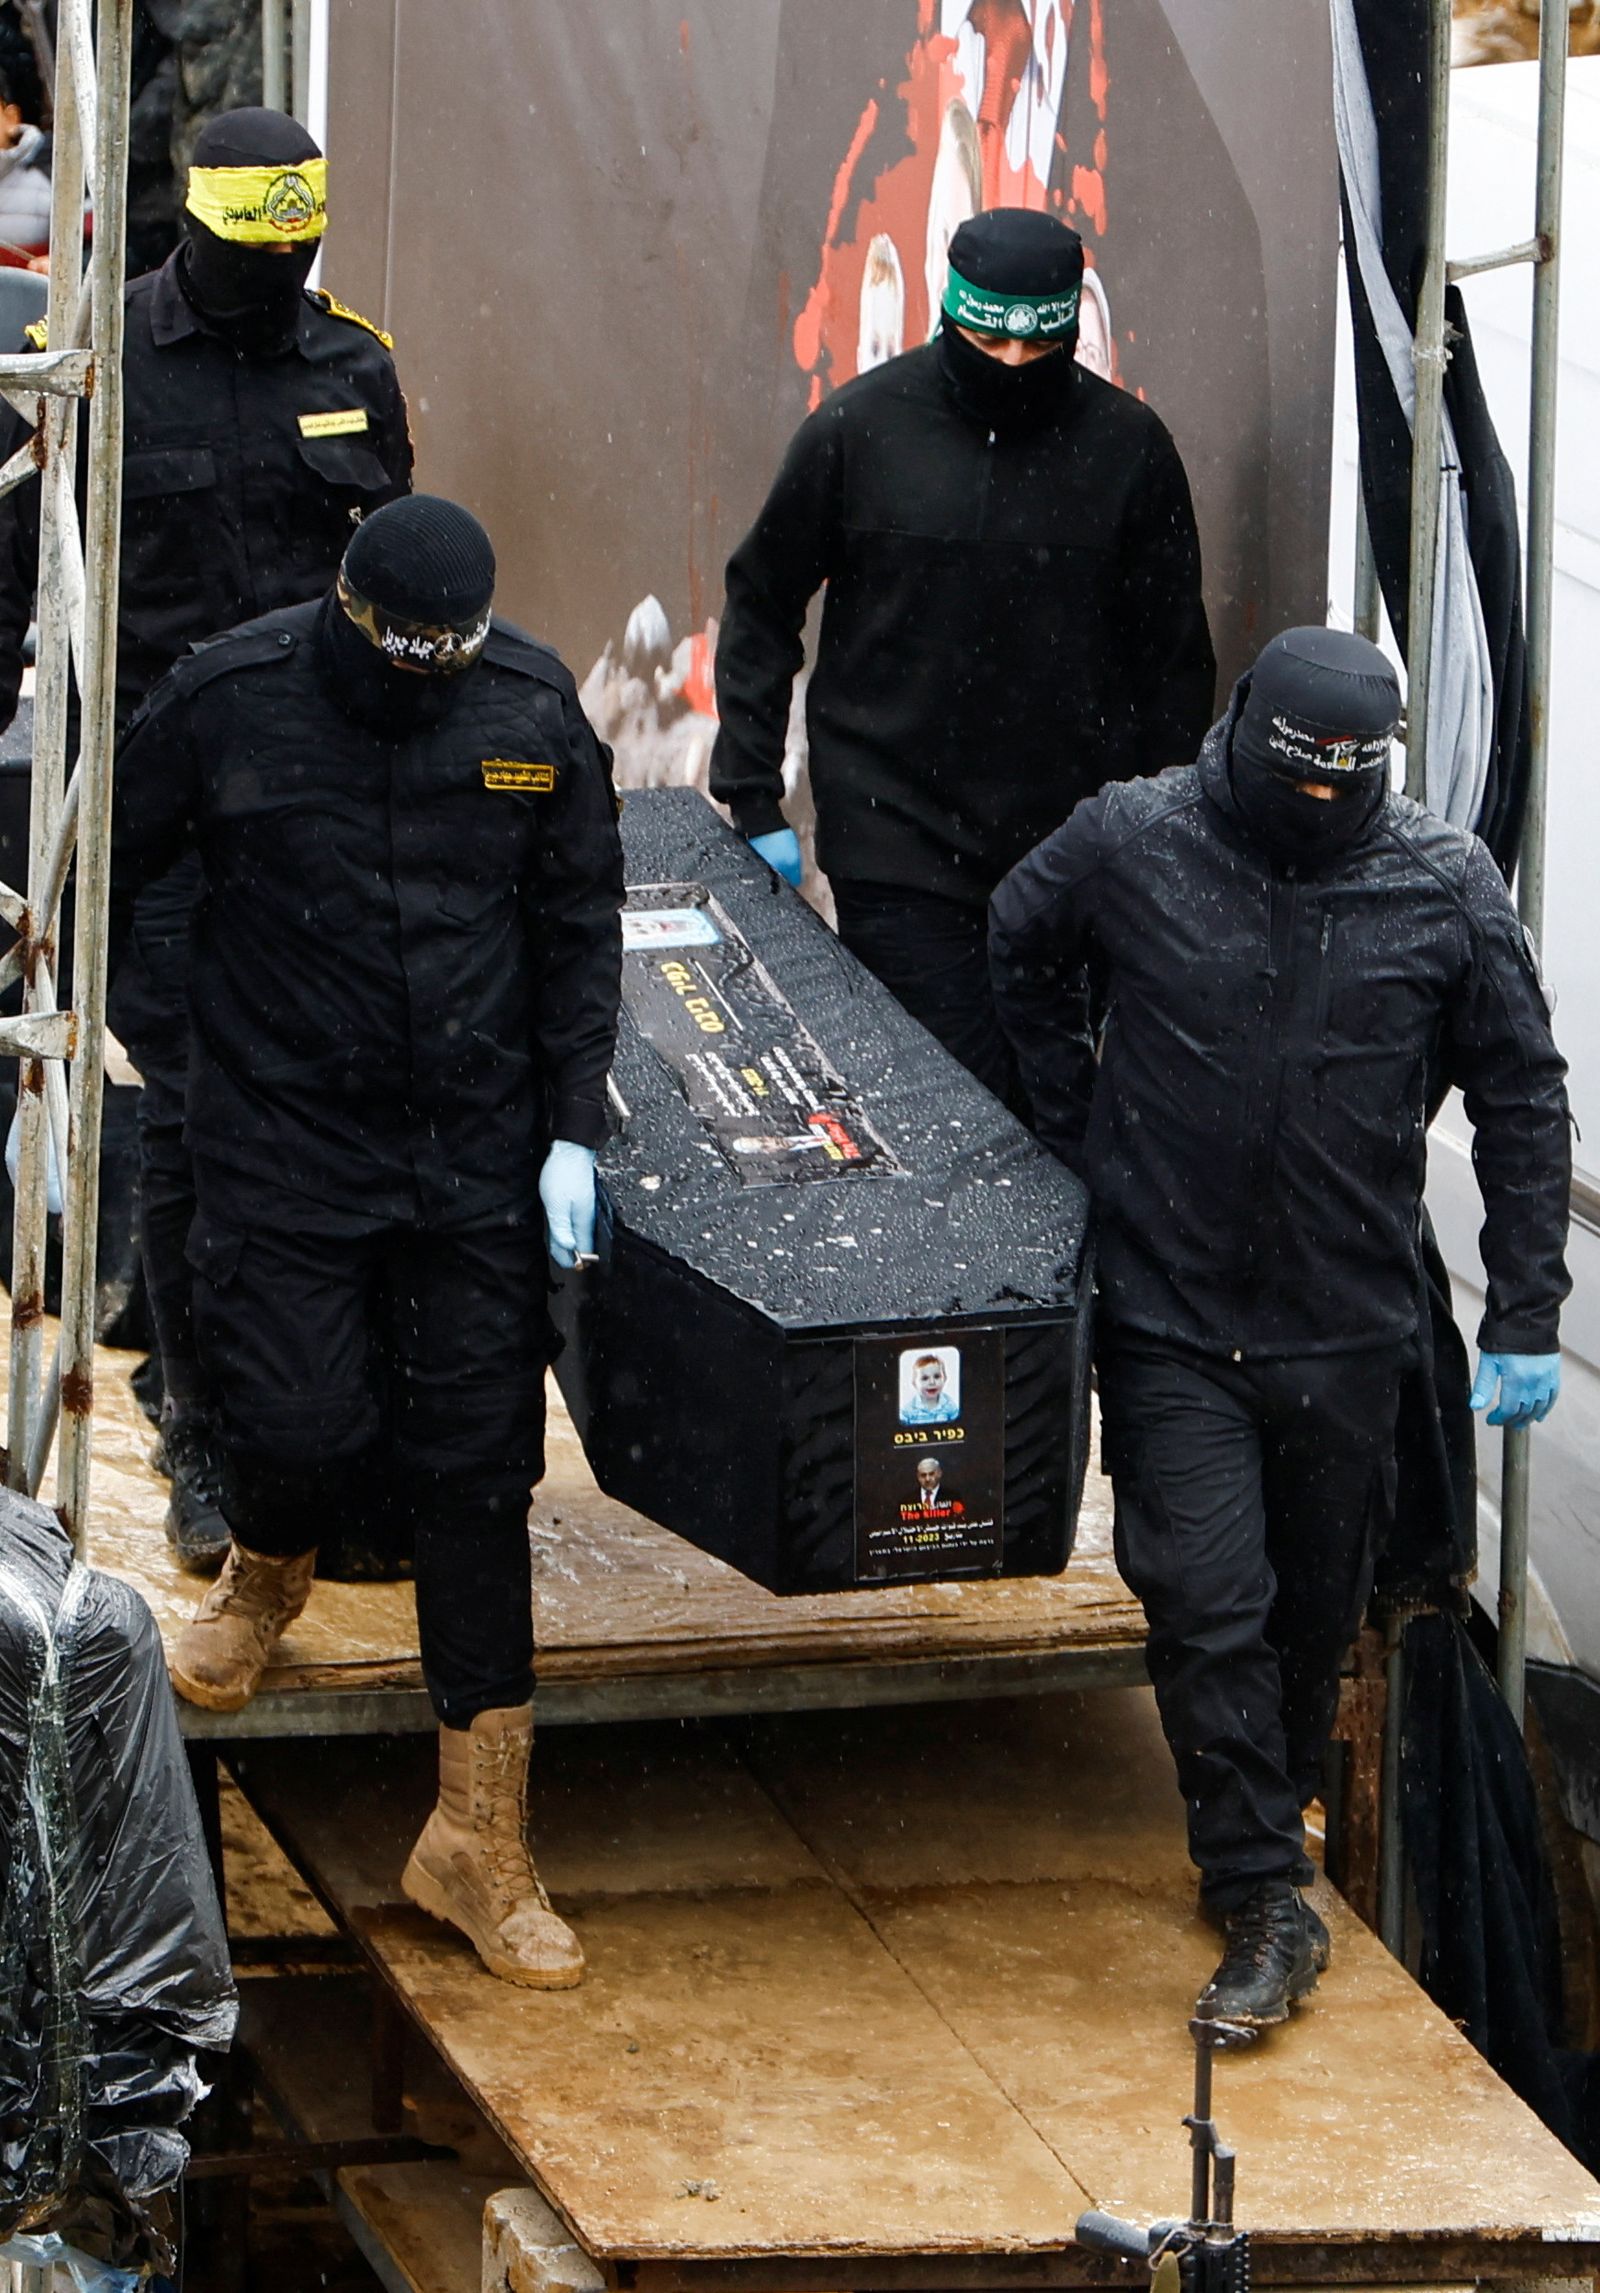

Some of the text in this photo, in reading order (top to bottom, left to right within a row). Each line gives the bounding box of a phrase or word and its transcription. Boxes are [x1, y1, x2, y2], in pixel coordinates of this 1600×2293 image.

[660, 961, 698, 997] כפיר
[685, 997, 725, 1033] ביבס
[894, 1427, 965, 1445] כפיר ביבס
[901, 1510, 921, 1521] The
